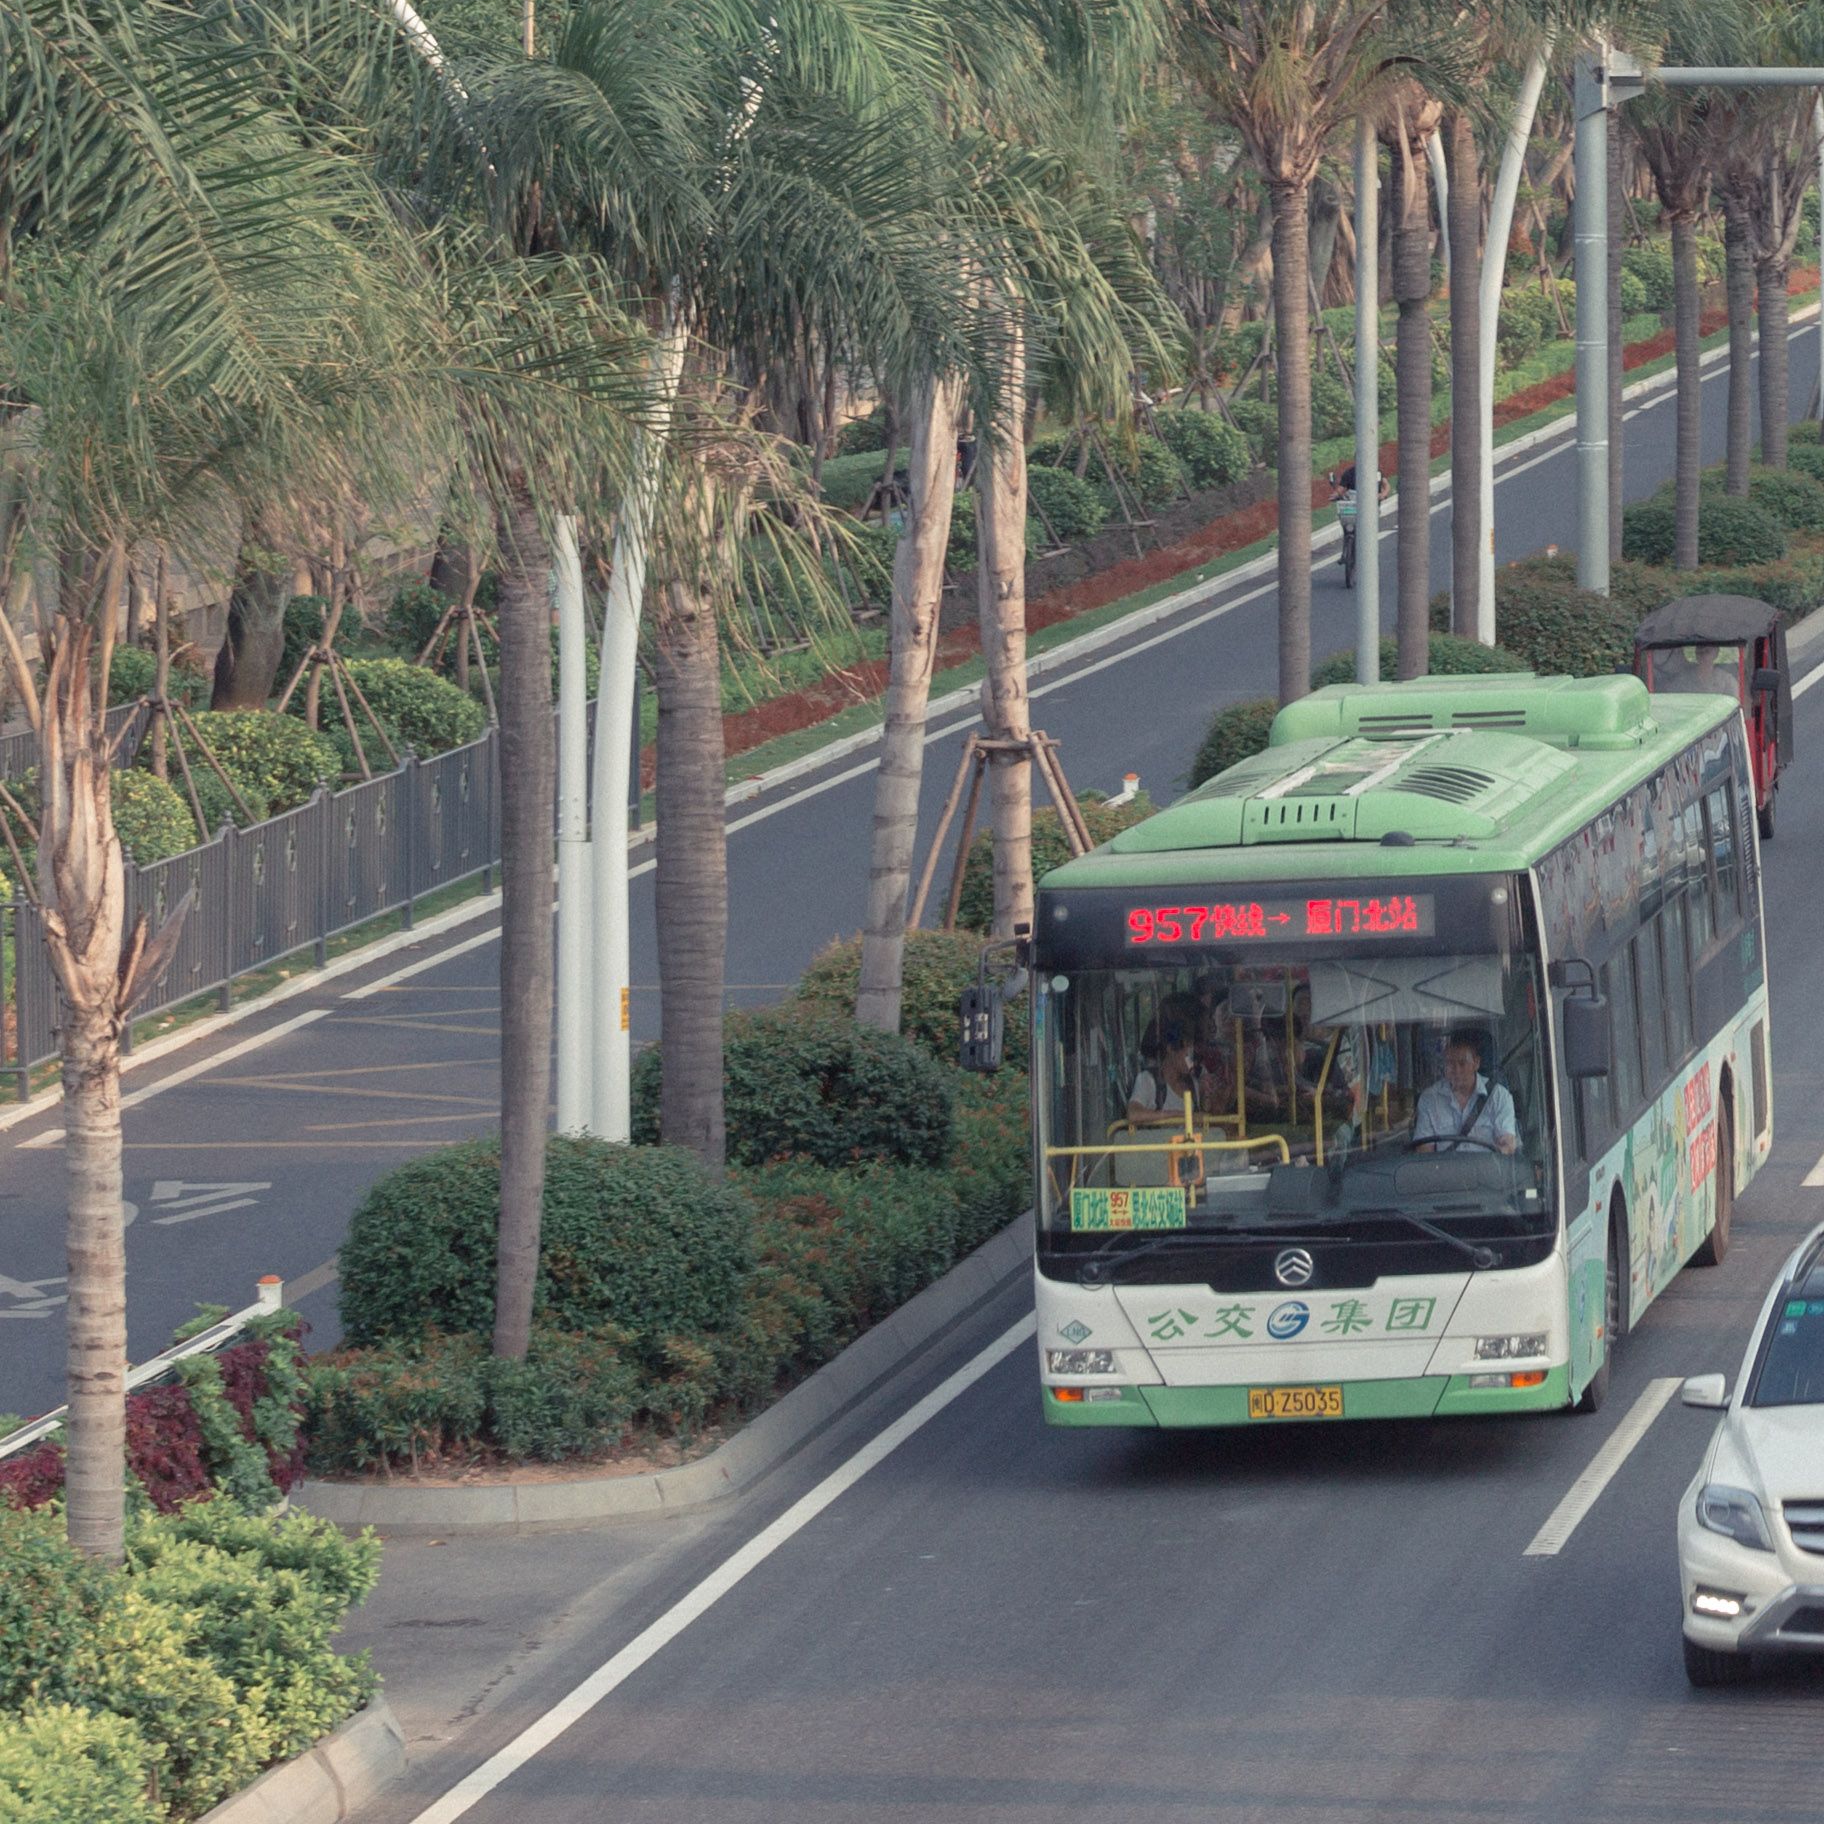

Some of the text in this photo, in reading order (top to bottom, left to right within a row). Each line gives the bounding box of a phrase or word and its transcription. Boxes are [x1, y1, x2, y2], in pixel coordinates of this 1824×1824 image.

[1306, 895, 1418, 935] 厦门北站
[1109, 1190, 1130, 1208] 957
